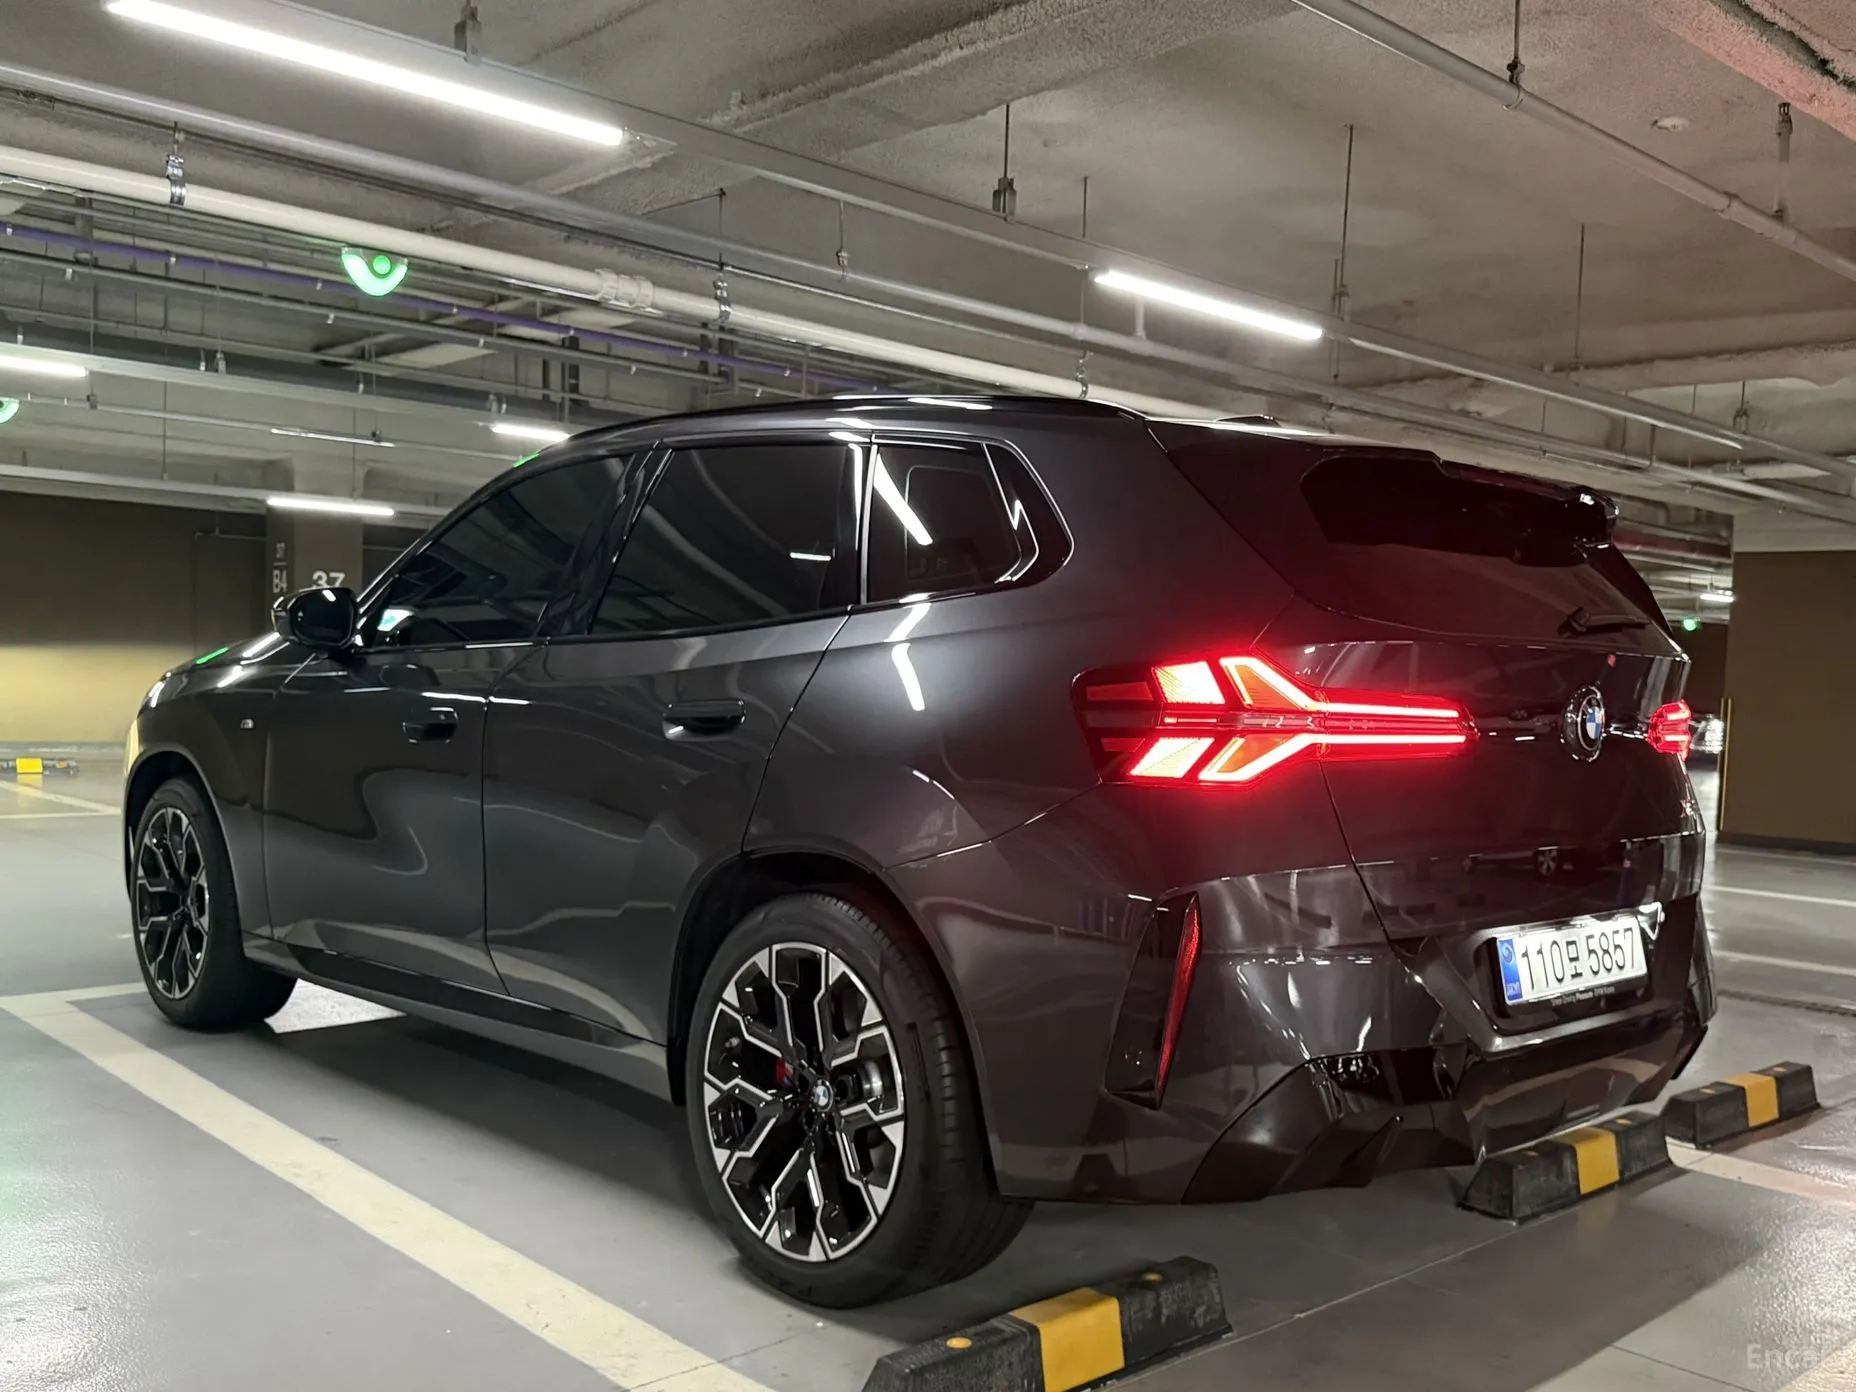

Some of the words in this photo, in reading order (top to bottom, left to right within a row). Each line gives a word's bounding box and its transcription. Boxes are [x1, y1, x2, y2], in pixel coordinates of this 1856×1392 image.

[272, 569, 288, 593] B4
[312, 570, 346, 589] 37
[1586, 927, 1635, 976] 5857
